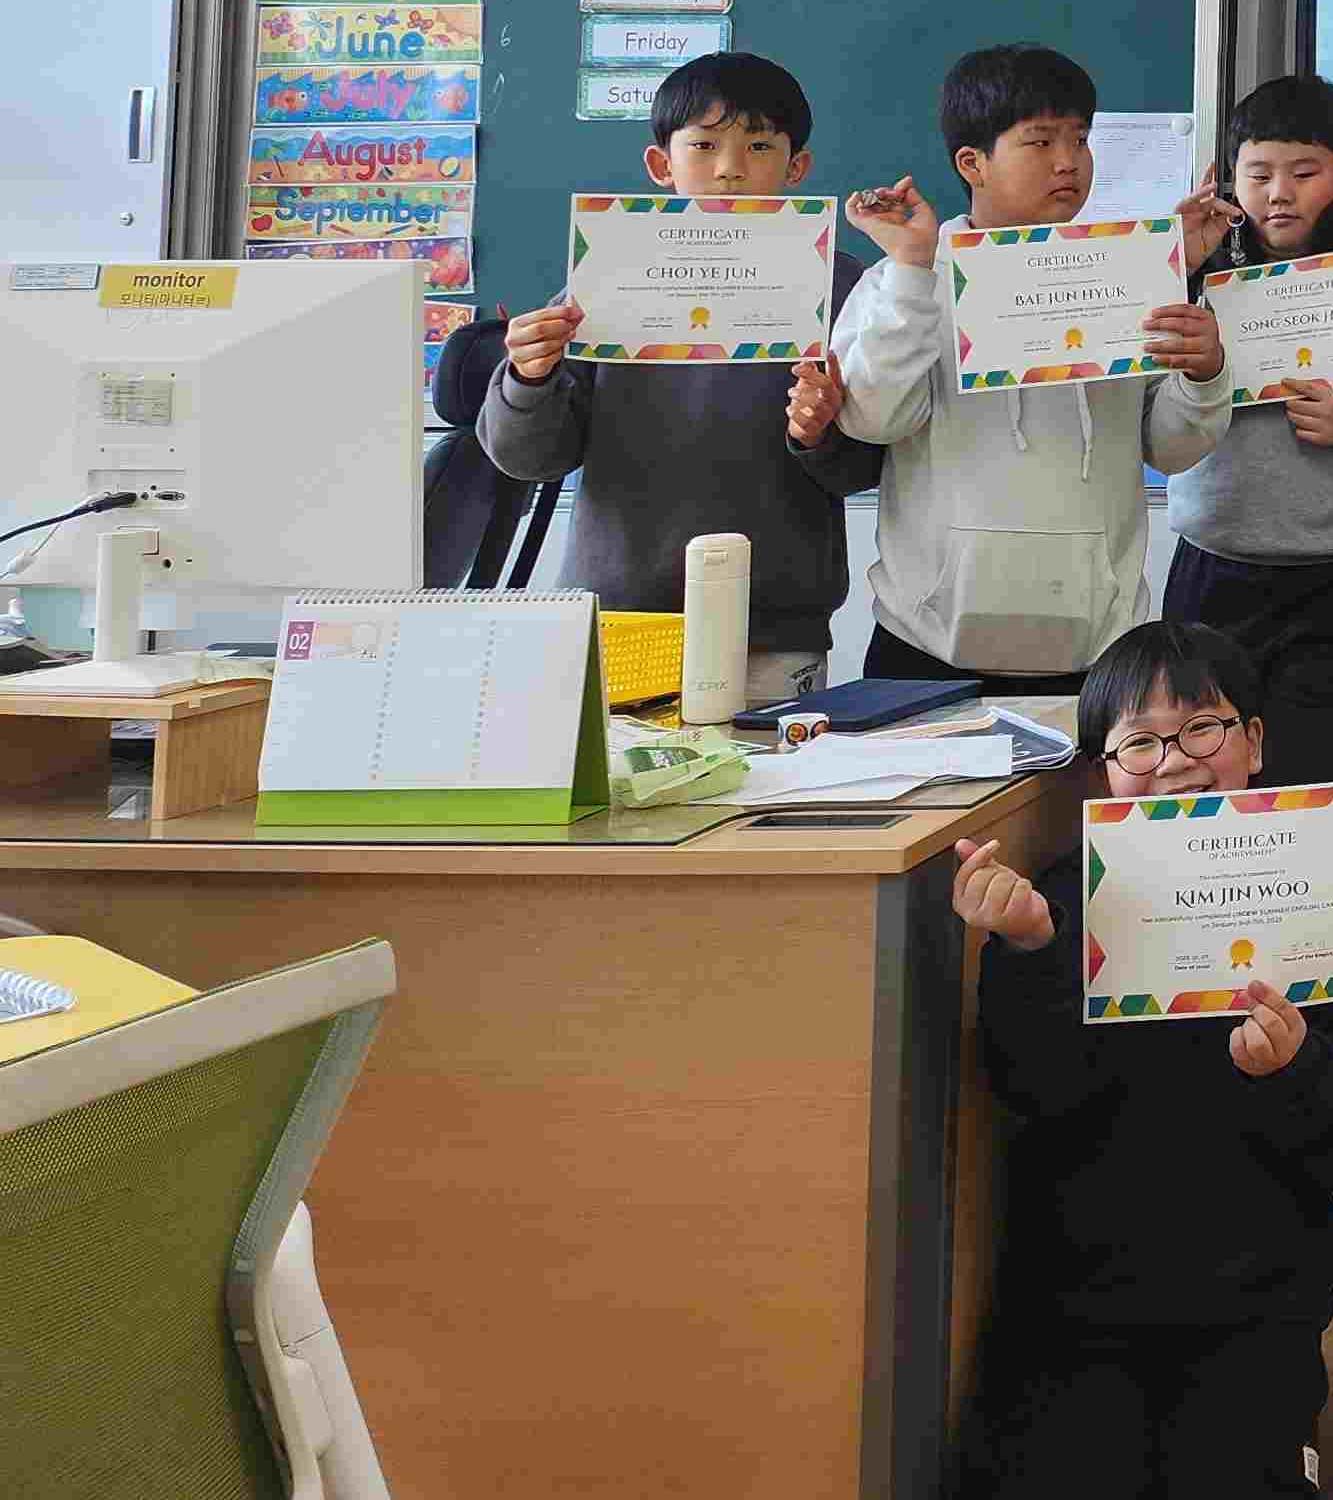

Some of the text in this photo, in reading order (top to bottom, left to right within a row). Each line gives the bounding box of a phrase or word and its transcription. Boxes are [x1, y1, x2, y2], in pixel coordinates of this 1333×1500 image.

[315, 16, 425, 58] June
[624, 32, 689, 55] Friday
[319, 69, 416, 121] July
[607, 86, 657, 106] Satu
[297, 130, 426, 180] August
[275, 186, 449, 236] September
[658, 228, 751, 240] CERTIFICATE
[1026, 252, 1110, 269] CERTIFICATE
[132, 271, 206, 289] monitor
[646, 266, 757, 280] CHOI YE JUN
[1015, 293, 1046, 308] BAE
[1082, 286, 1128, 302] HYUK
[1240, 318, 1281, 334] SONG
[1284, 313, 1321, 327] SEOK
[288, 632, 310, 651] 02
[1186, 831, 1297, 853] CERTIFICATE
[1174, 878, 1310, 909] KIM JIN WOO
